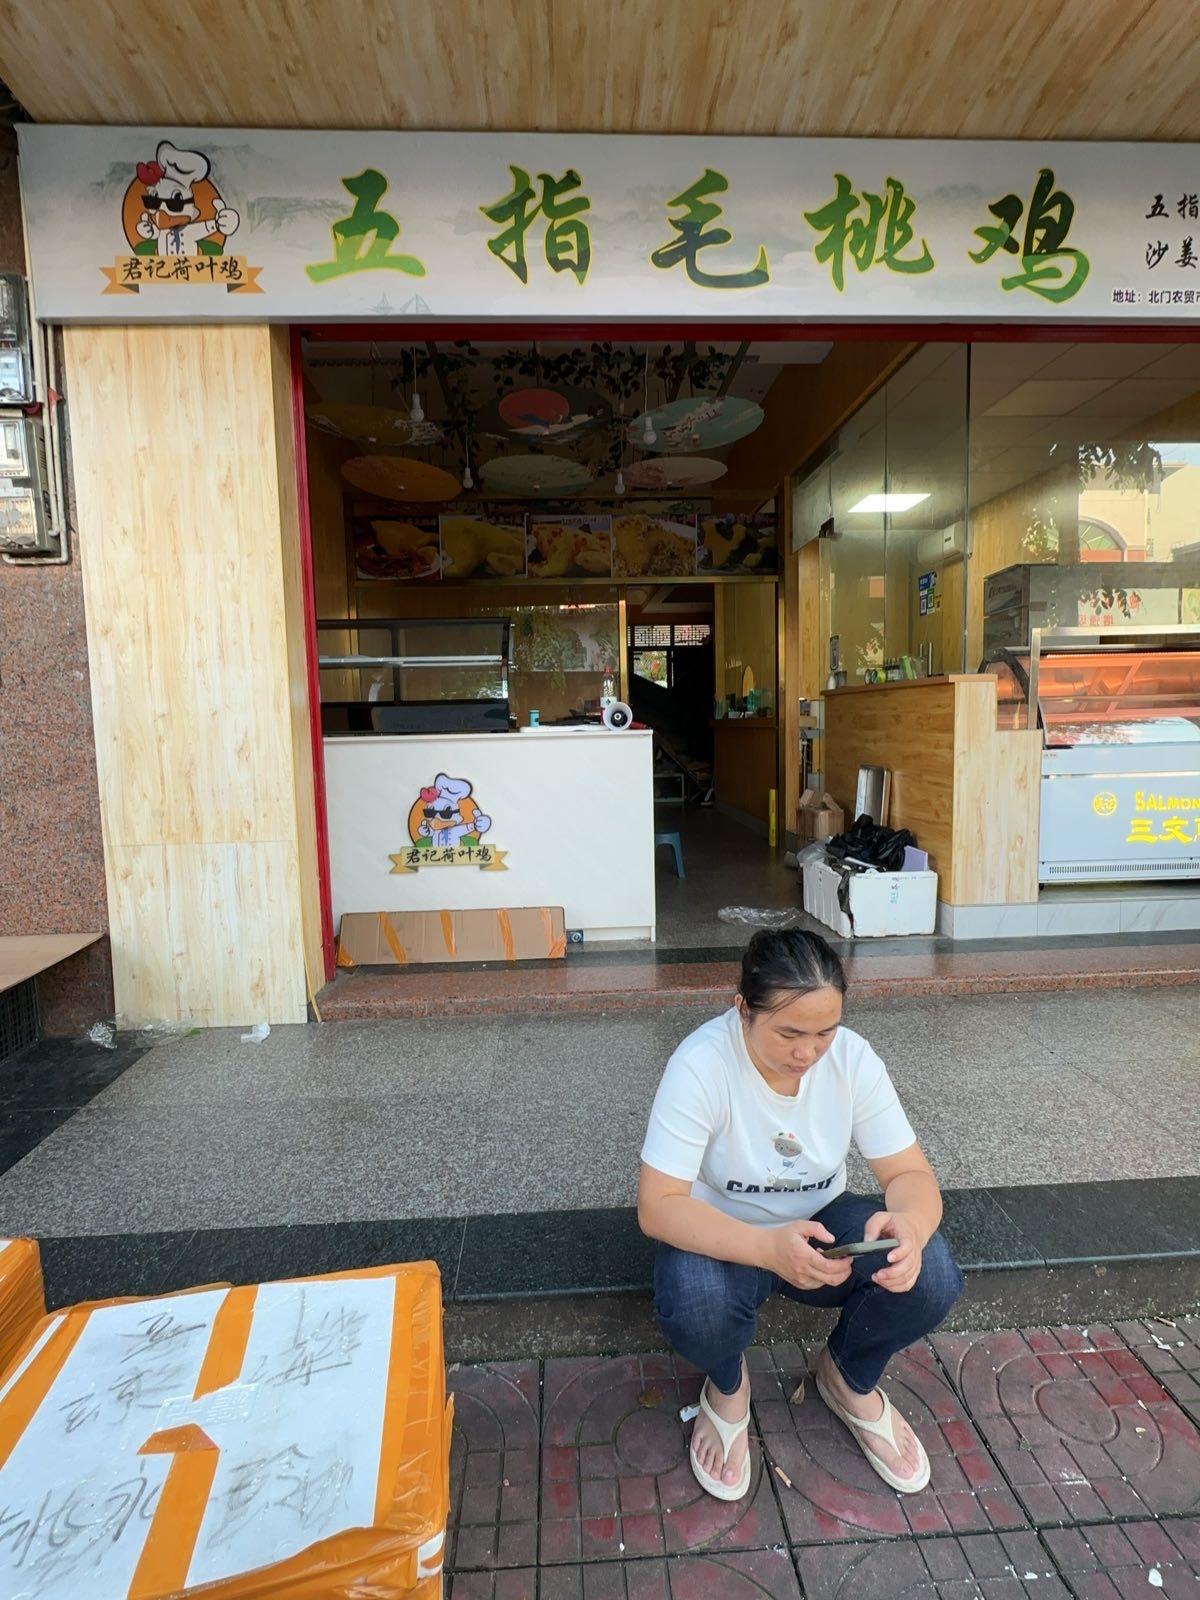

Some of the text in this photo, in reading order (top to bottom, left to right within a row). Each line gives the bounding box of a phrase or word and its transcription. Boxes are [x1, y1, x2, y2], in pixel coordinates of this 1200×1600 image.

[1145, 193, 1199, 220] 五指
[306, 163, 1091, 303] 五指毛桃鸡
[1145, 236, 1199, 270] 沙姜
[122, 256, 243, 282] 君记荷叶鸡
[1126, 816, 1200, 844] 三文
[406, 846, 492, 864] 君记荷叶鸡
